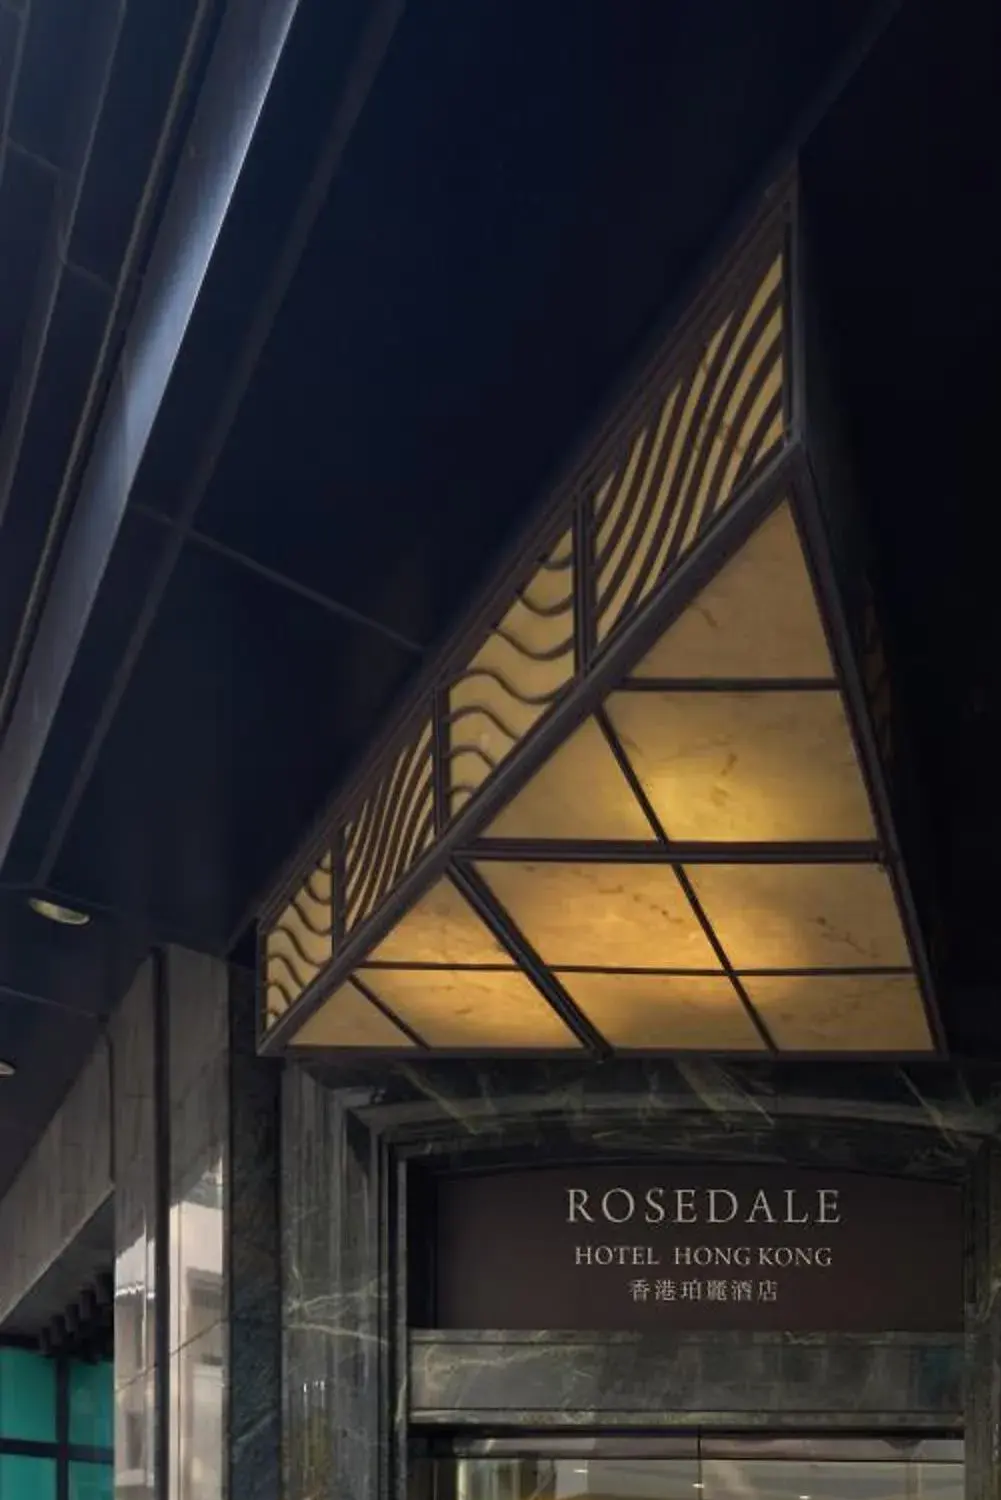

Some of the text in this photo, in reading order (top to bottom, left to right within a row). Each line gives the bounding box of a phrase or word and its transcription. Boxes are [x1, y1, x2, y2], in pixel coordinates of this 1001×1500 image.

[566, 1187, 842, 1224] ROSEDALE
[574, 1245, 833, 1267] HOTEL HONG KONG
[629, 1278, 779, 1302] 香港珀麗酒店
